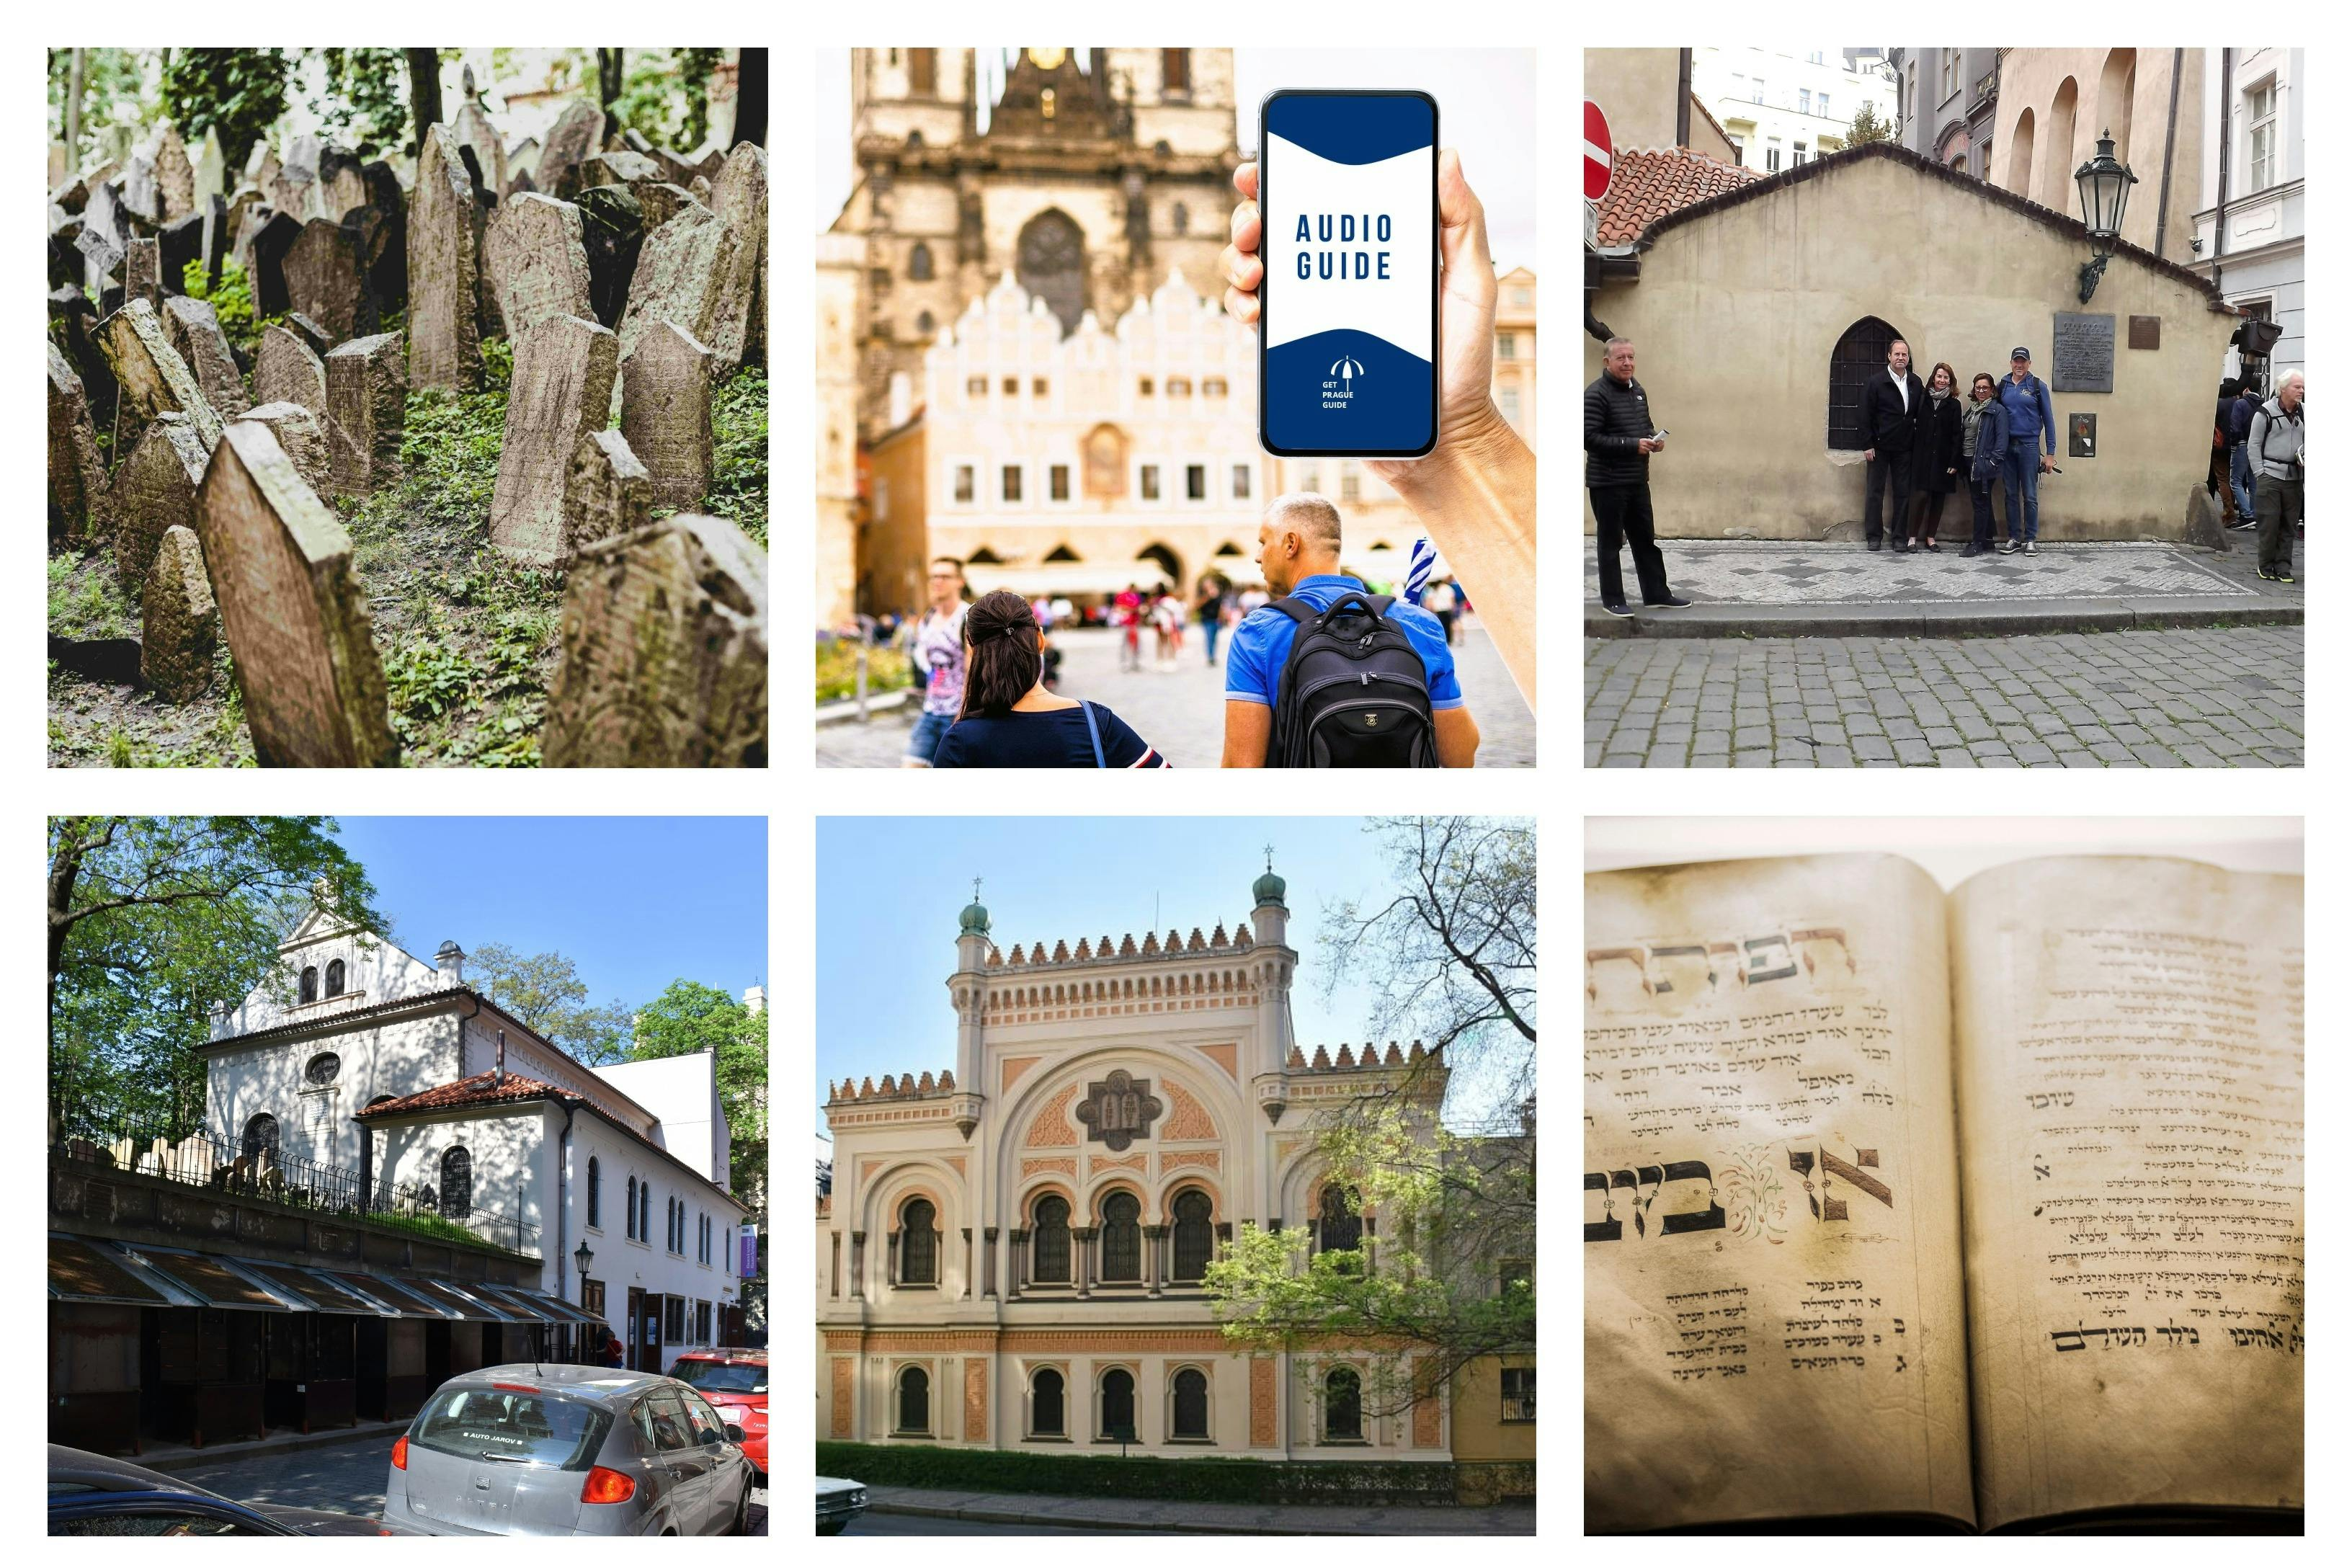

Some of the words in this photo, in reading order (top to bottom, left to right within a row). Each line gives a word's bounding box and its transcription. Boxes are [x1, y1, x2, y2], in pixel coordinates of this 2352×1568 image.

[1296, 214, 1391, 242] AUDIO
[1297, 252, 1390, 280] GUIDE
[491, 1435, 516, 1445] JAROV
